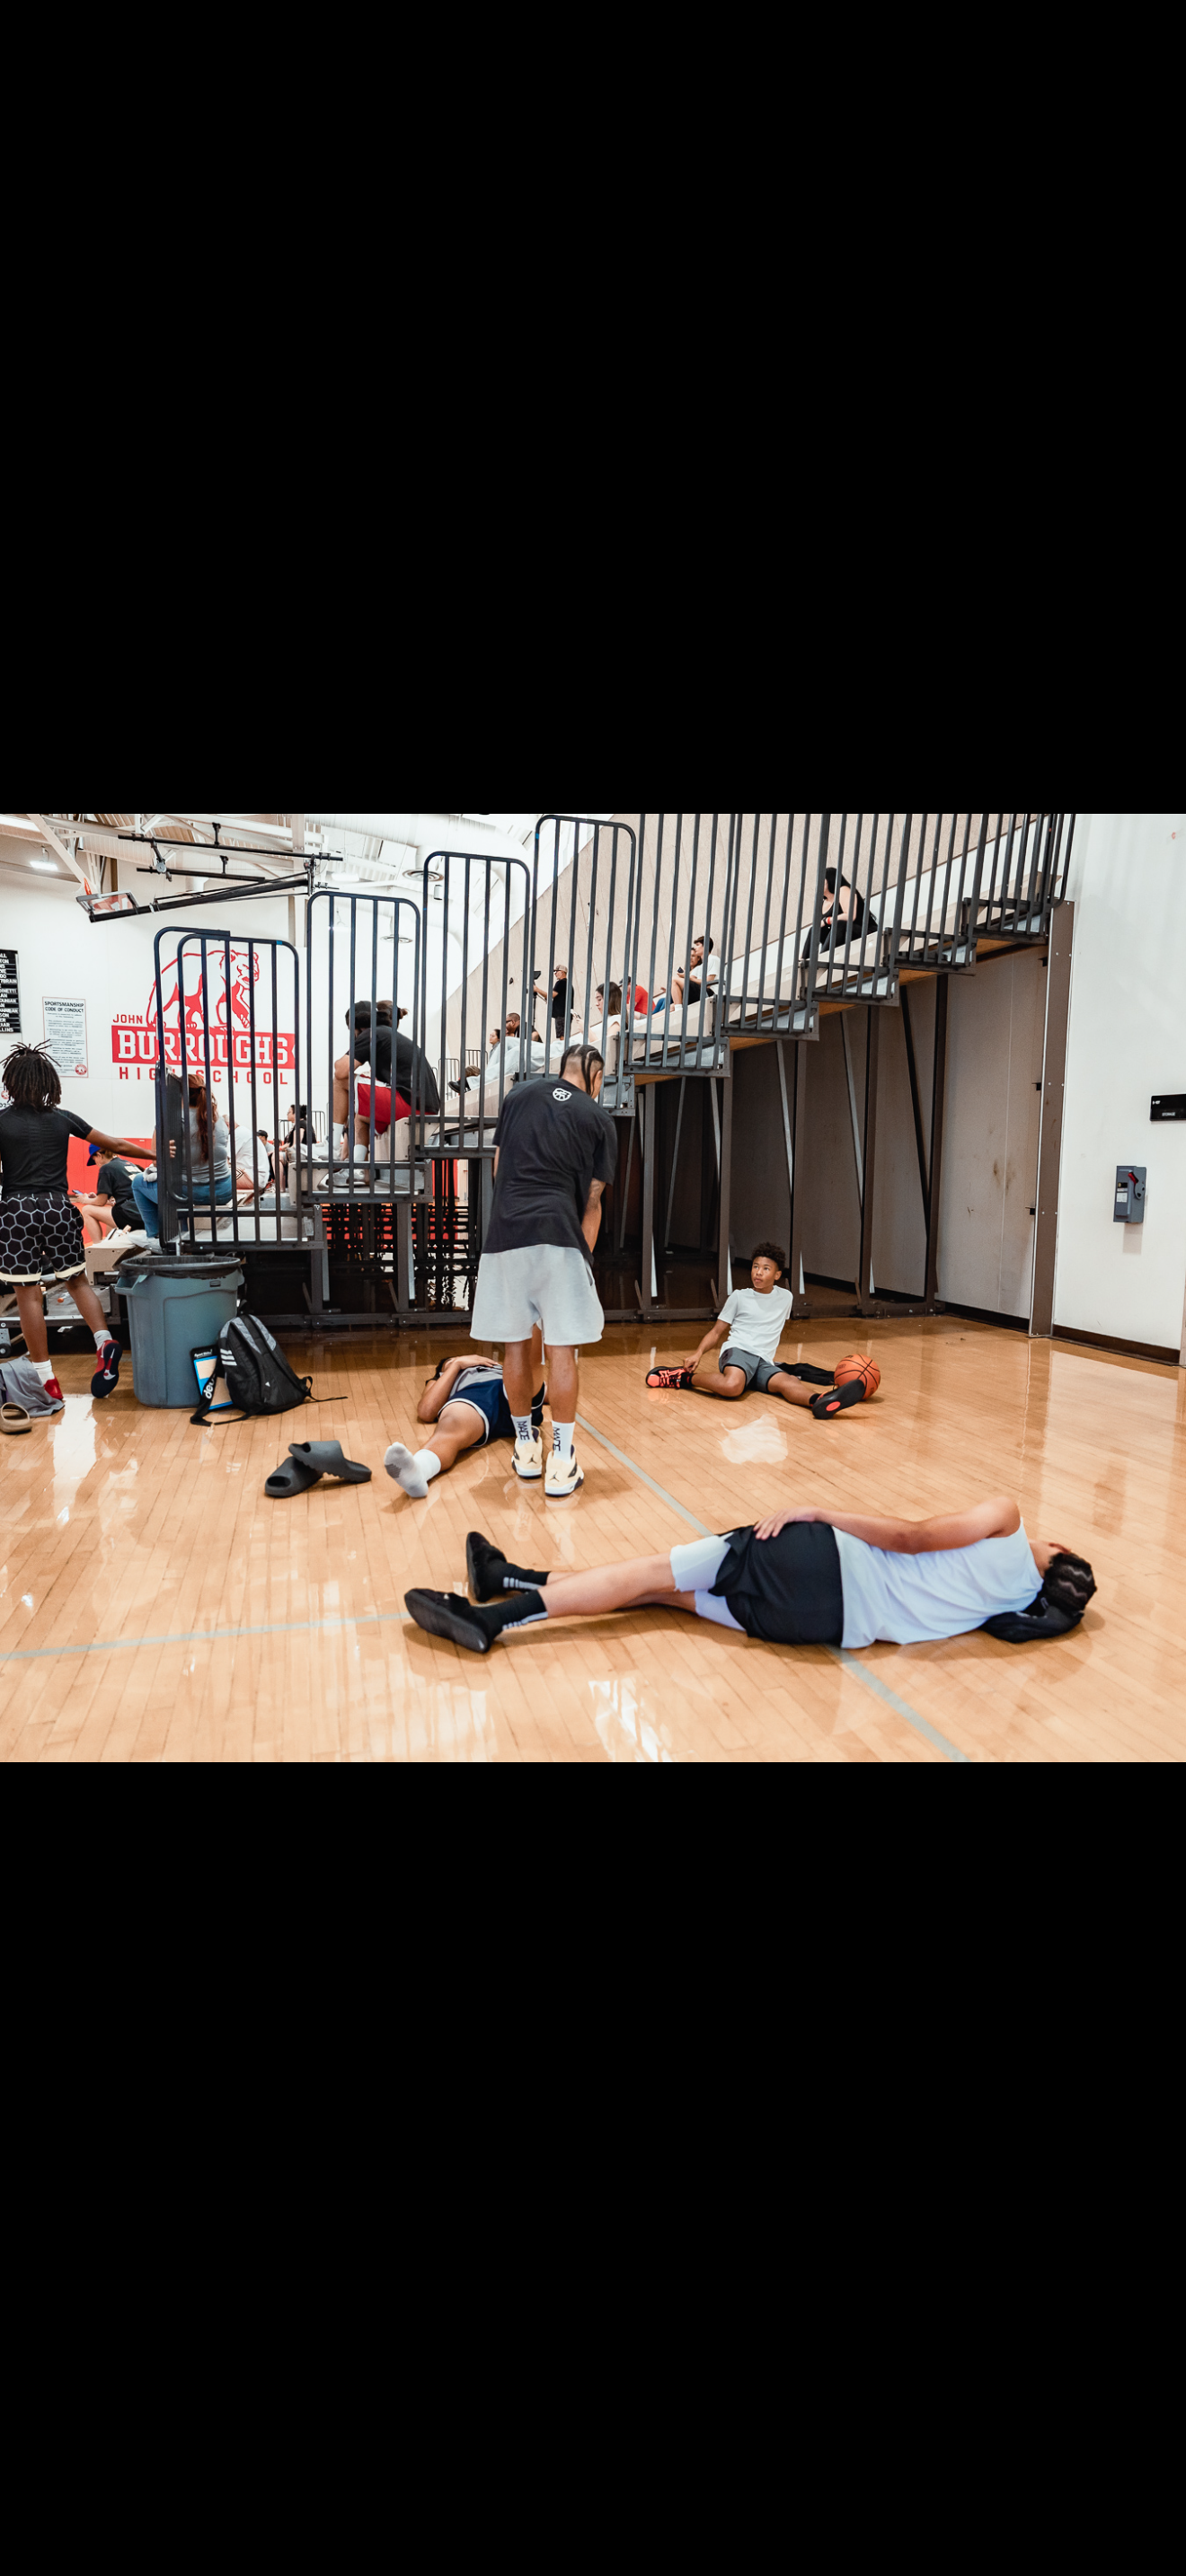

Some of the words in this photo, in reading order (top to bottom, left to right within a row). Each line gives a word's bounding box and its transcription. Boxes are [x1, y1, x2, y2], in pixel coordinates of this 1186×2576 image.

[112, 1014, 144, 1025] JOHN
[117, 1029, 289, 1066] BURROUGHS
[119, 1066, 176, 1081] HIG
